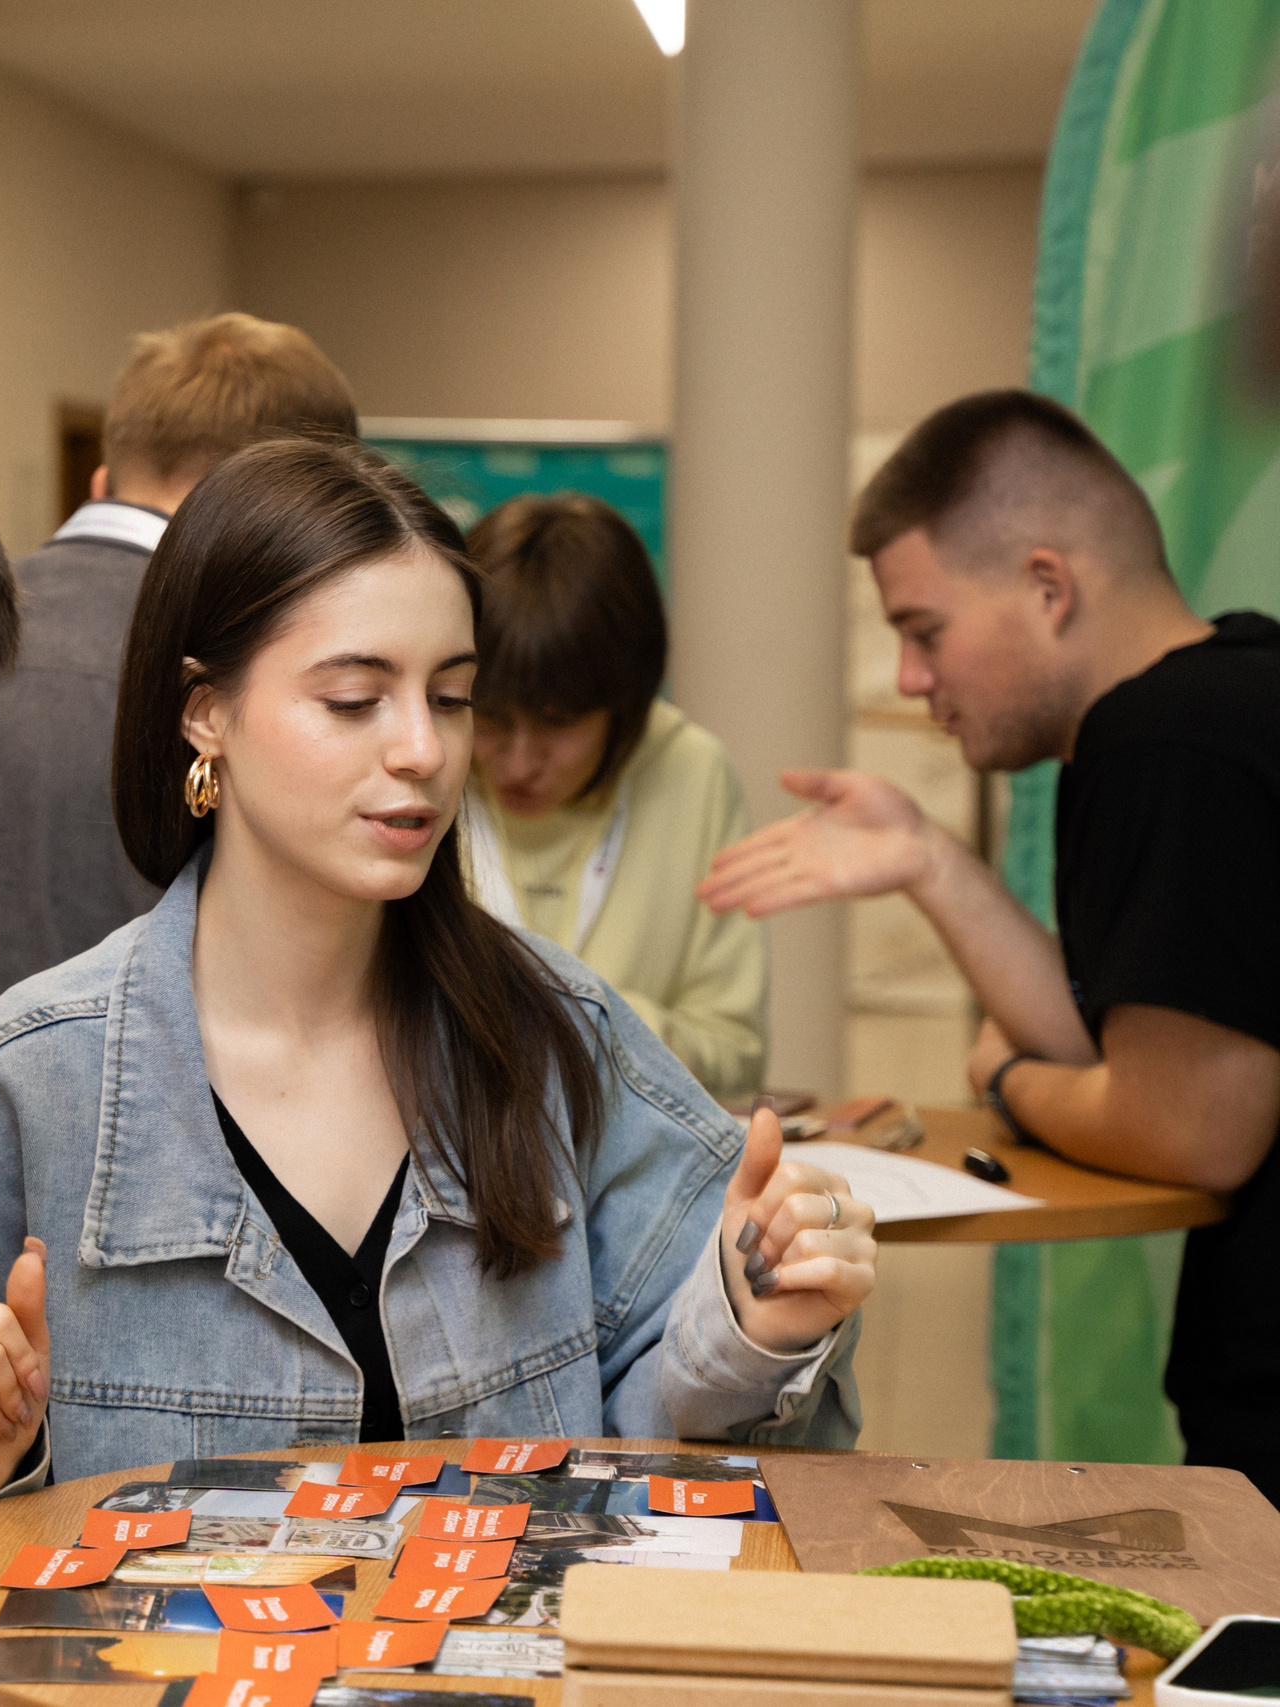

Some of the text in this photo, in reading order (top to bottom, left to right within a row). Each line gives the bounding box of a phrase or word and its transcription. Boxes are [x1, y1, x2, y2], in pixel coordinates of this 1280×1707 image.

[691, 1492, 708, 1504] Село
[134, 1523, 152, 1538] Стена
[927, 1547, 1196, 1563] МОЛОДЁЖЬ
[33, 1549, 72, 1586] Константиново
[62, 1560, 84, 1574] Село
